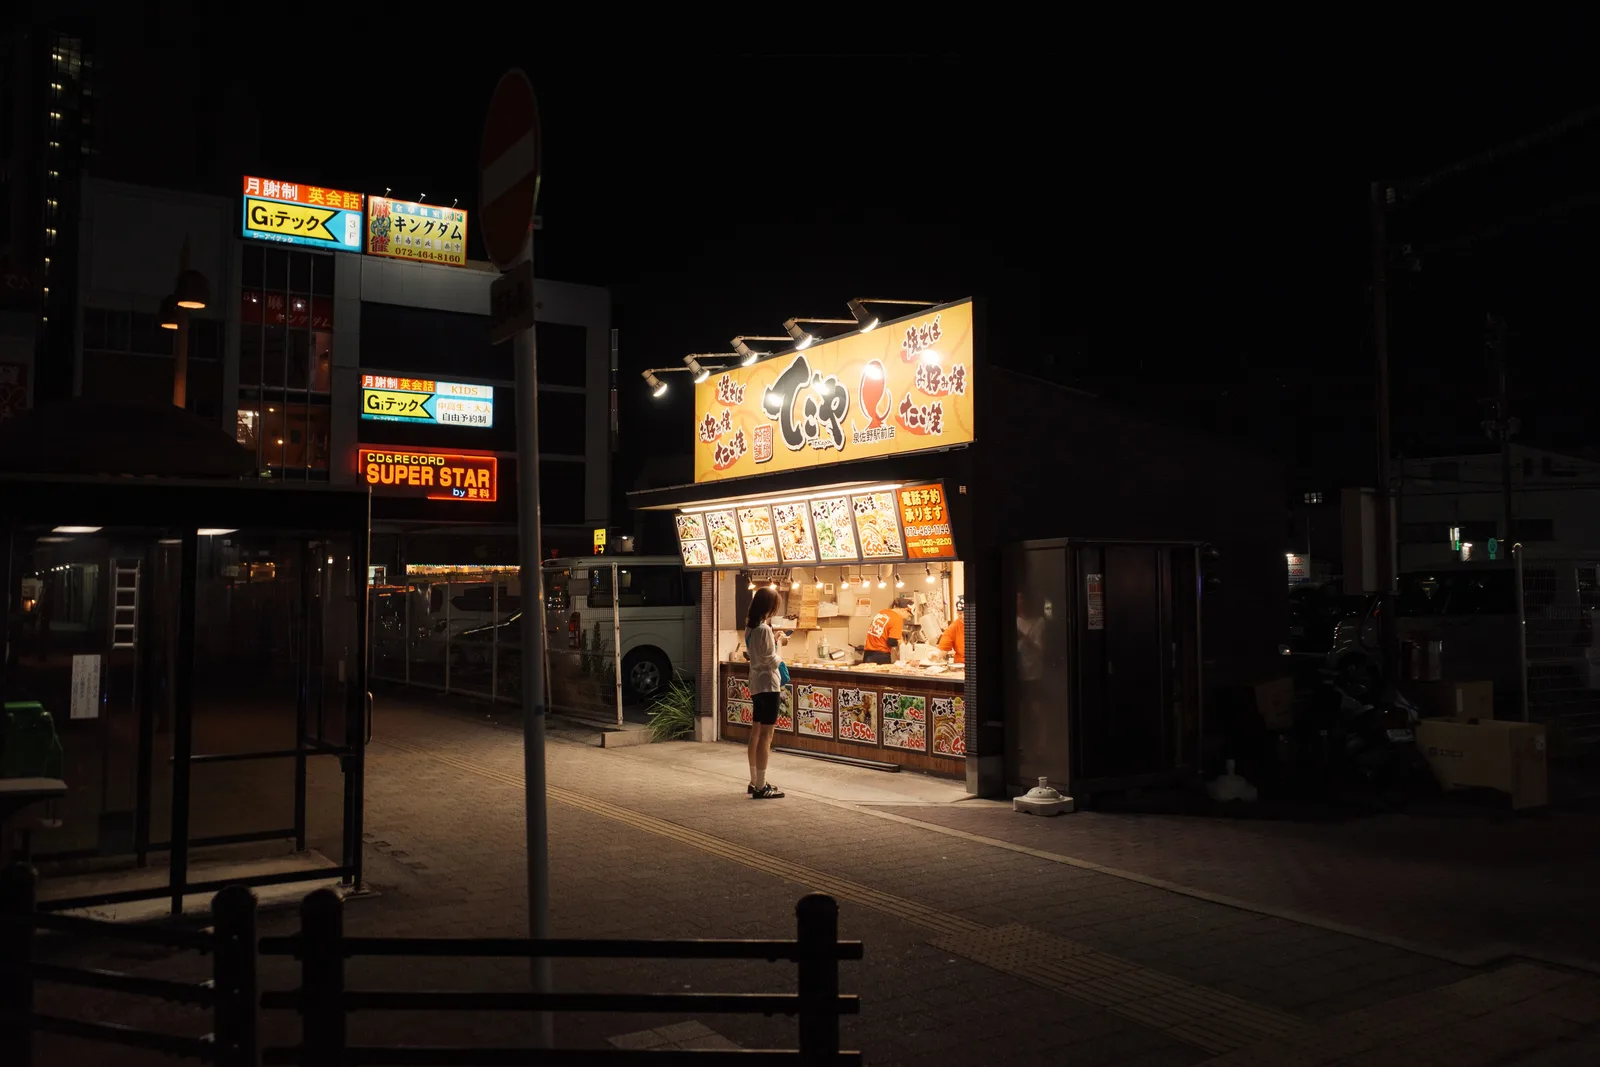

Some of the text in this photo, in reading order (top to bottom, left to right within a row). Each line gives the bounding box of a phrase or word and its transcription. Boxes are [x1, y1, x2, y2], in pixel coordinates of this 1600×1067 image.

[246, 177, 360, 210] 月謝制 英会話
[251, 205, 320, 232] Giテック
[394, 216, 463, 241] キングダム
[395, 247, 461, 263] 072-464-8160
[364, 375, 434, 392] 月謝制 英会話
[451, 386, 479, 395] KIDS
[367, 394, 419, 413] Giテック
[367, 453, 445, 466] CD&RECORD
[366, 463, 490, 488] SUPER STAR
[452, 487, 466, 498] by
[901, 488, 942, 507] 電話予約
[904, 505, 943, 523] 承ります
